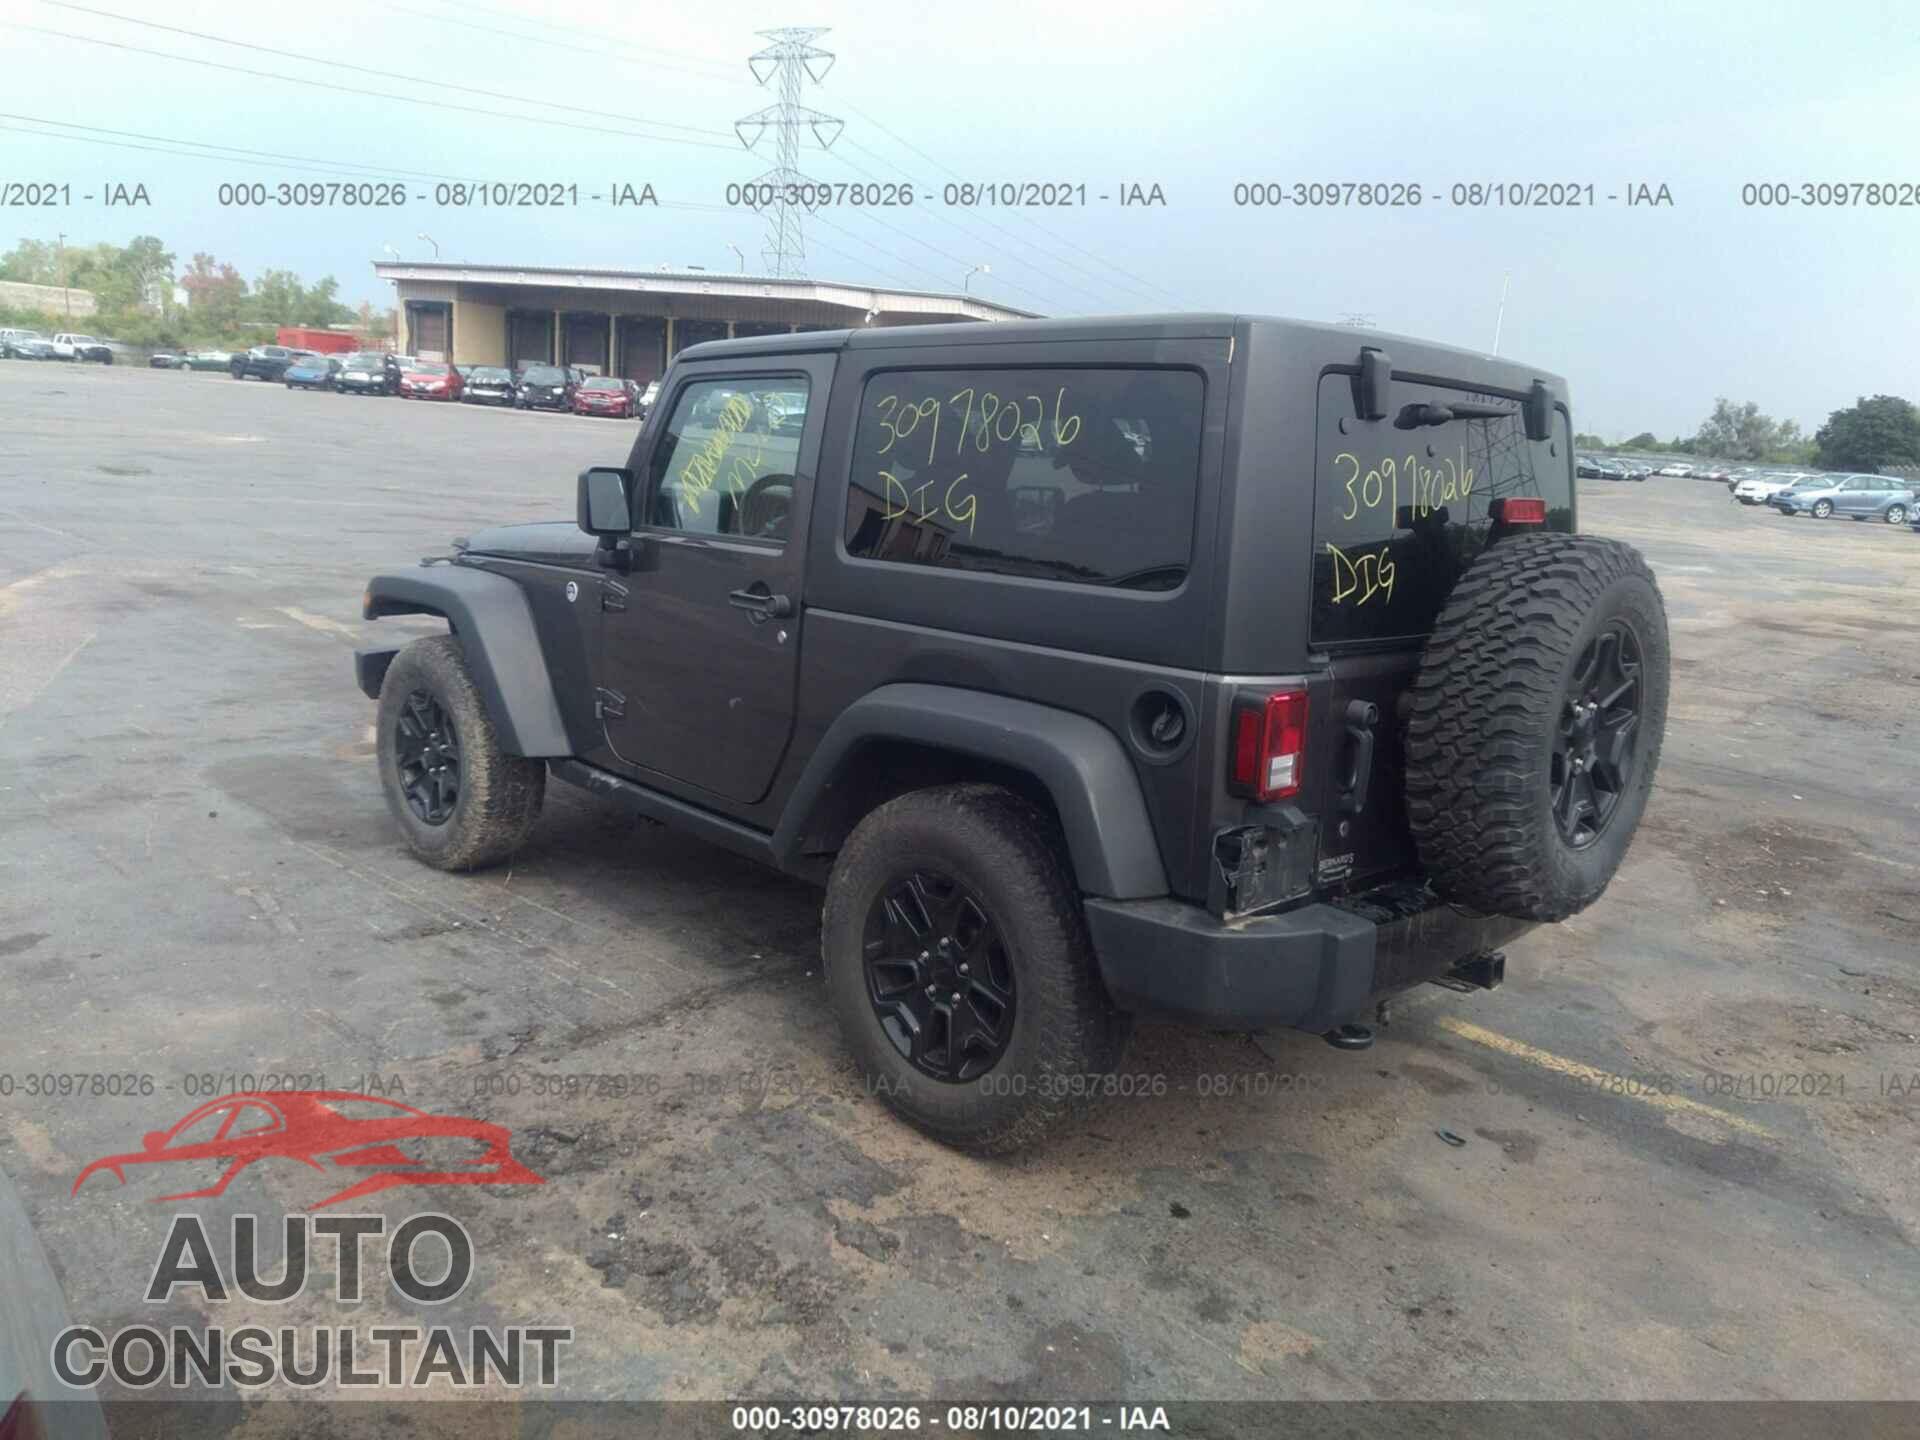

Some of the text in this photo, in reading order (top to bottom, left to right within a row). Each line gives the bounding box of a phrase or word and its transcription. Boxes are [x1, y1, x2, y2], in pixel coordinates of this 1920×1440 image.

[877, 387, 1081, 465] 30978026
[877, 471, 977, 539] DIG
[1334, 446, 1474, 529] 30978026
[1326, 542, 1396, 606] DIG
